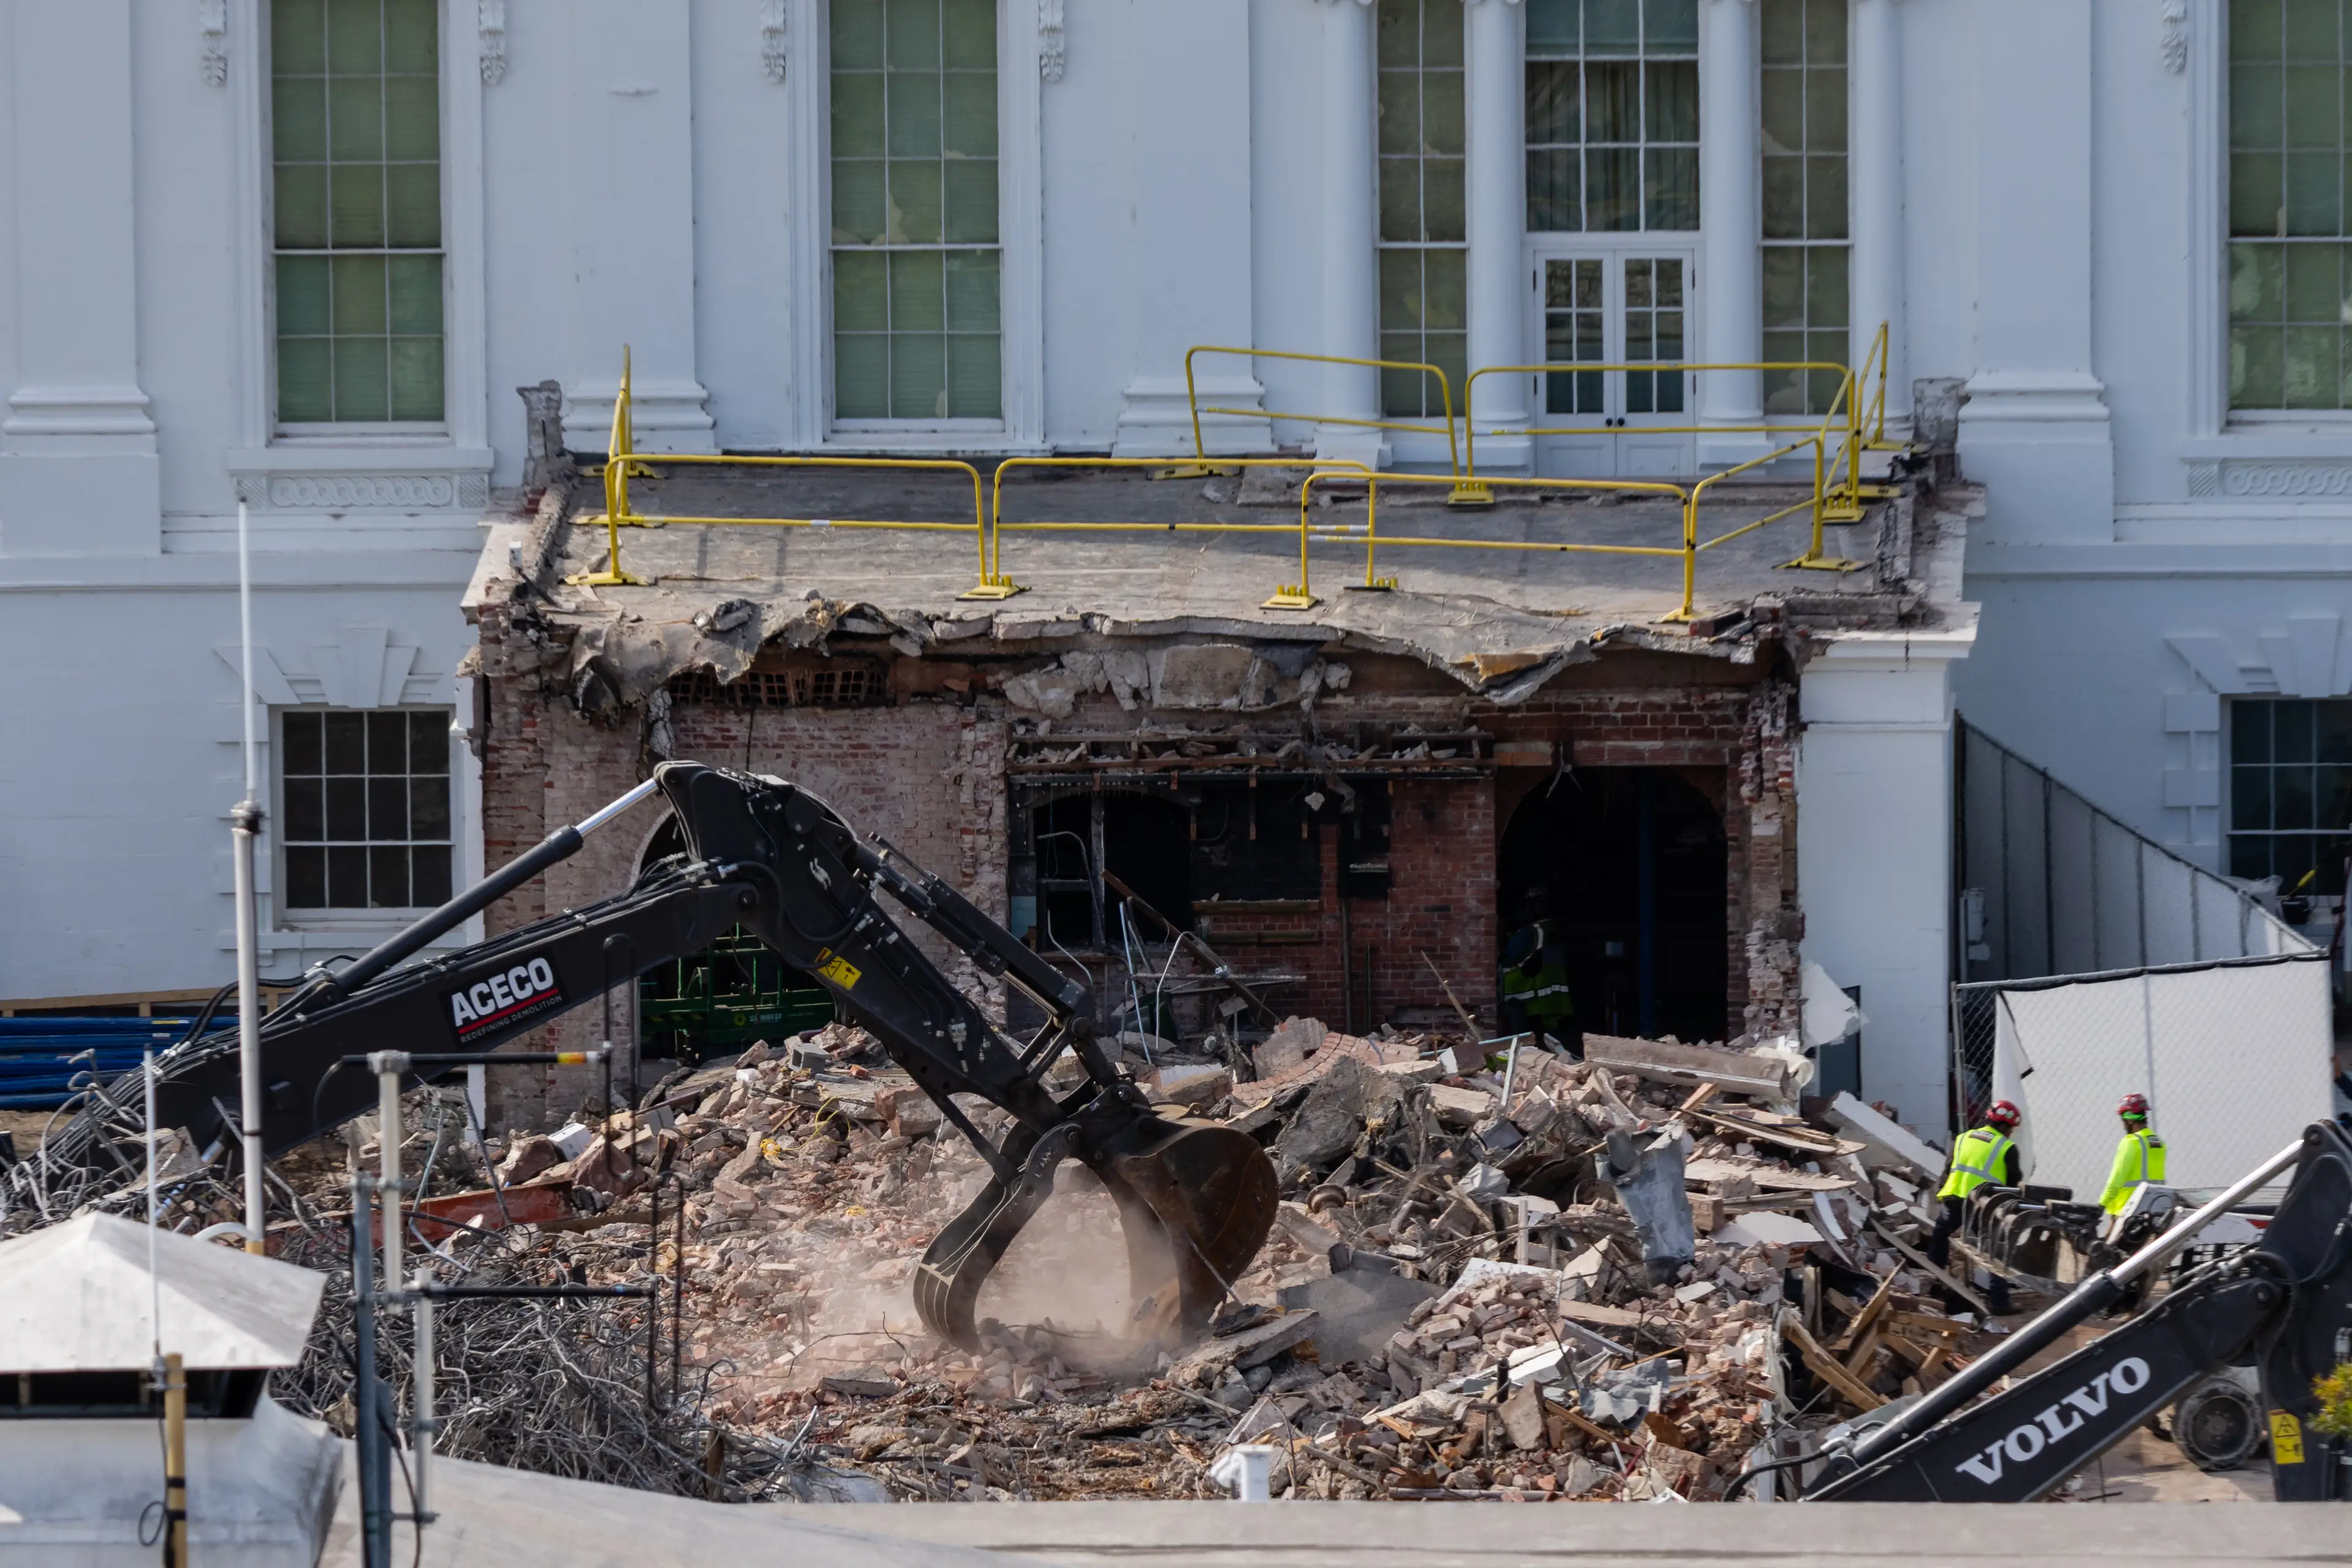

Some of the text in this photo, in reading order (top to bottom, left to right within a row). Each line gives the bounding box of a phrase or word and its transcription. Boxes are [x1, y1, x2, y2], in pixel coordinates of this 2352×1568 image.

[451, 957, 554, 1027] ACECO
[461, 995, 562, 1043] REDEFINING DEMOLITION
[1955, 1357, 2151, 1485] VOLVO
